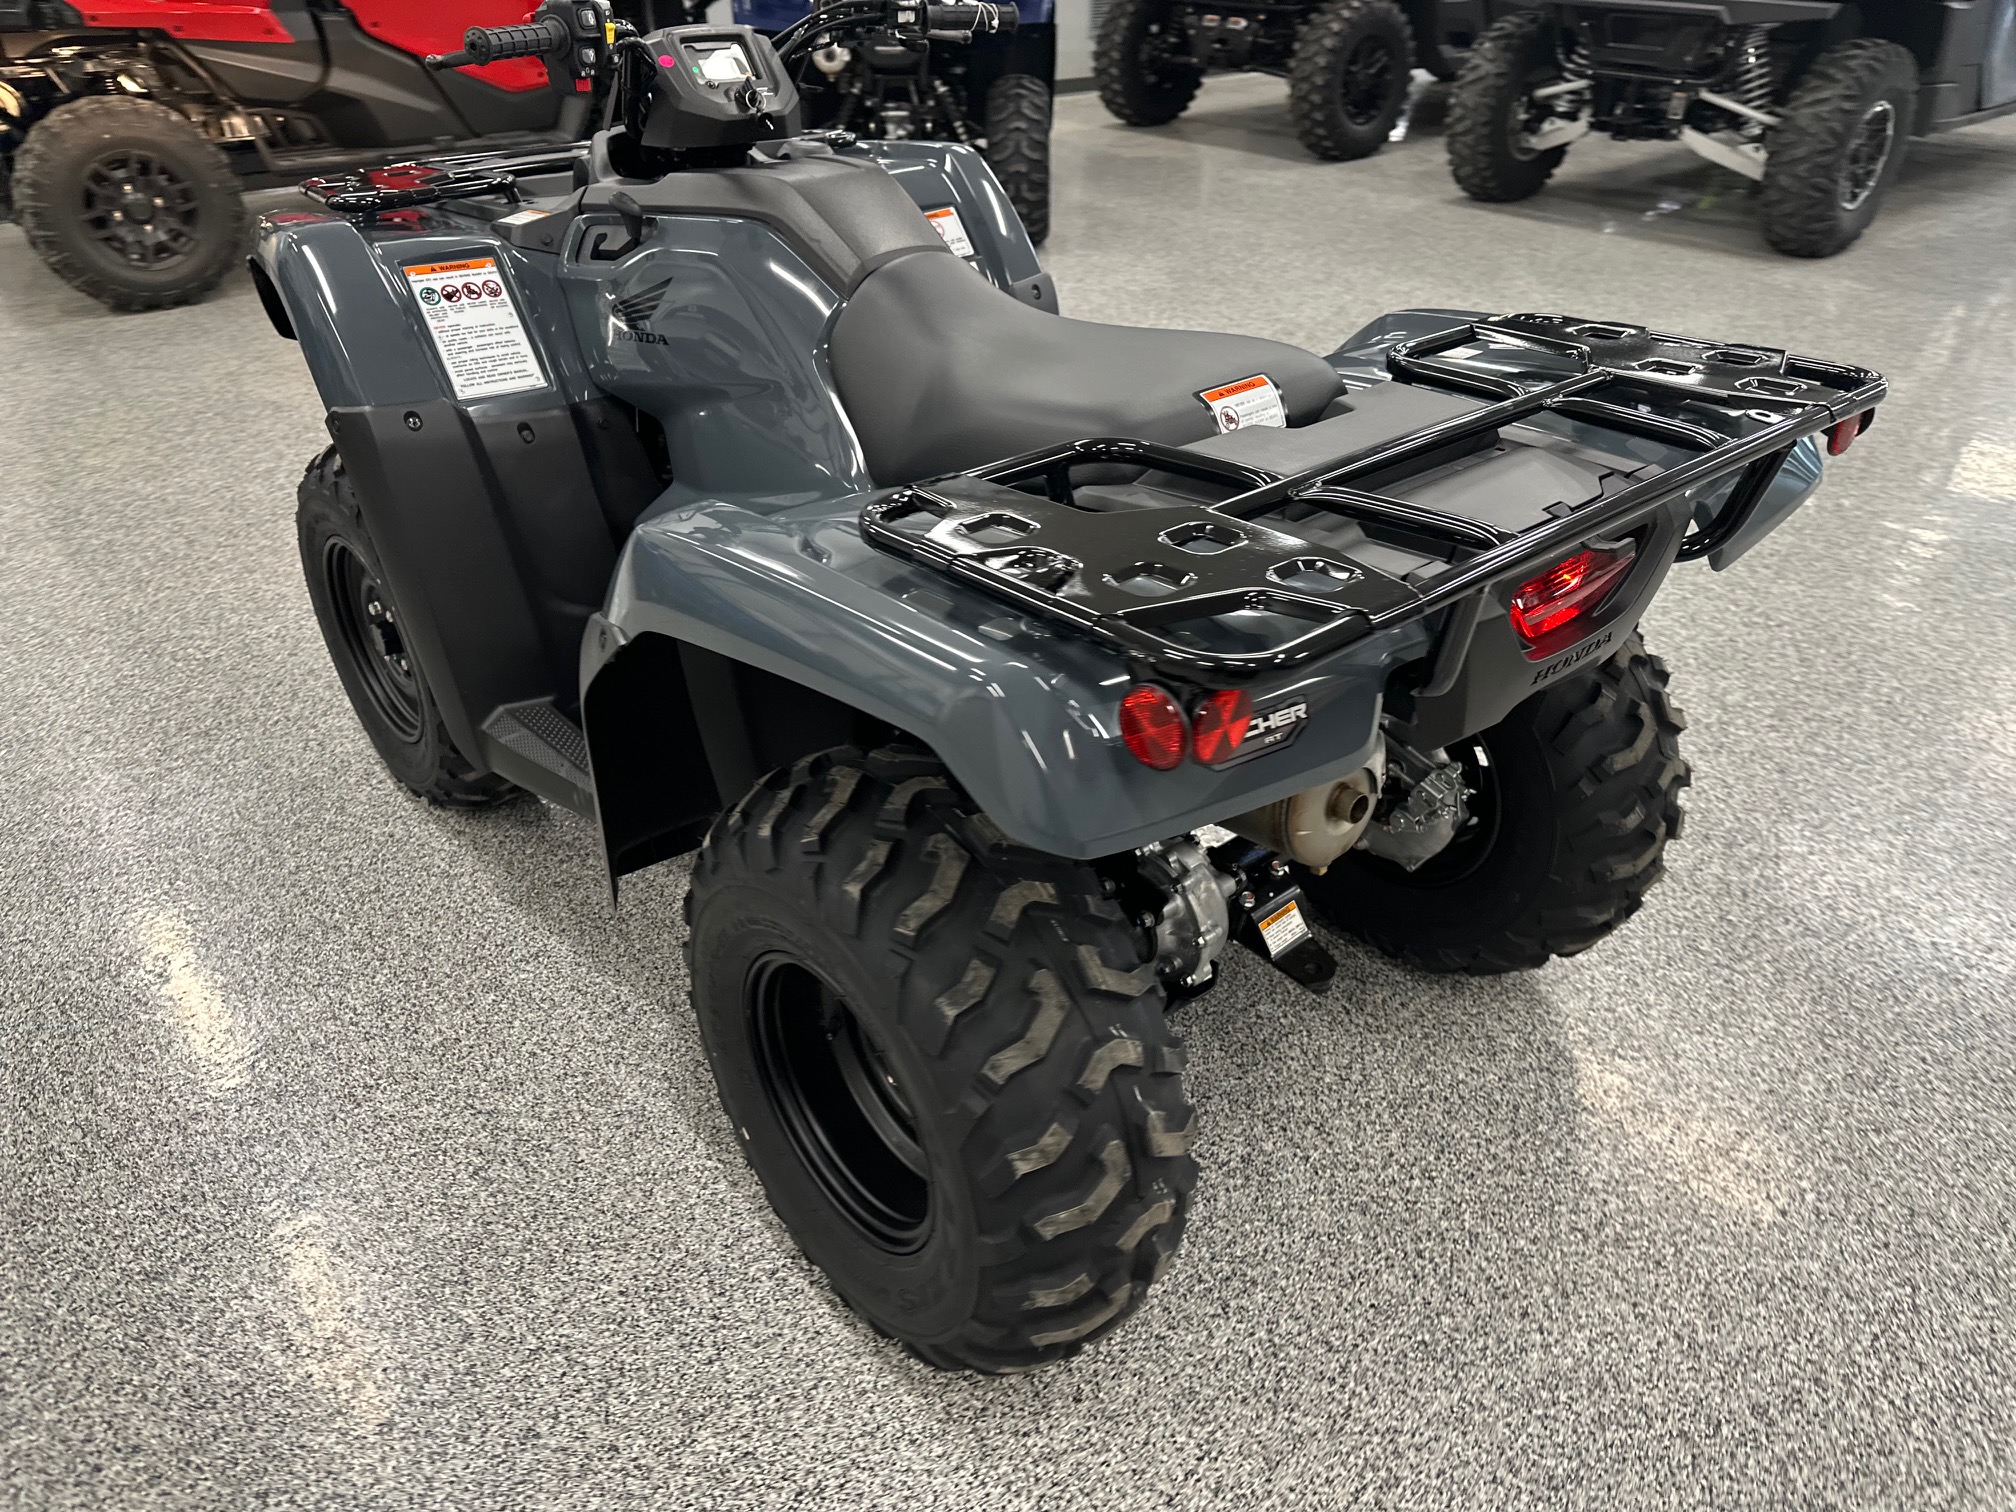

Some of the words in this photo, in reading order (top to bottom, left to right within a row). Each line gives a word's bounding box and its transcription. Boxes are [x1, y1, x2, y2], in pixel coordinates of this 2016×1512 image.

[440, 262, 470, 271] WARNING
[1224, 382, 1256, 394] WARNING
[1530, 632, 1612, 686] HONDA
[1244, 702, 1308, 738] CHER
